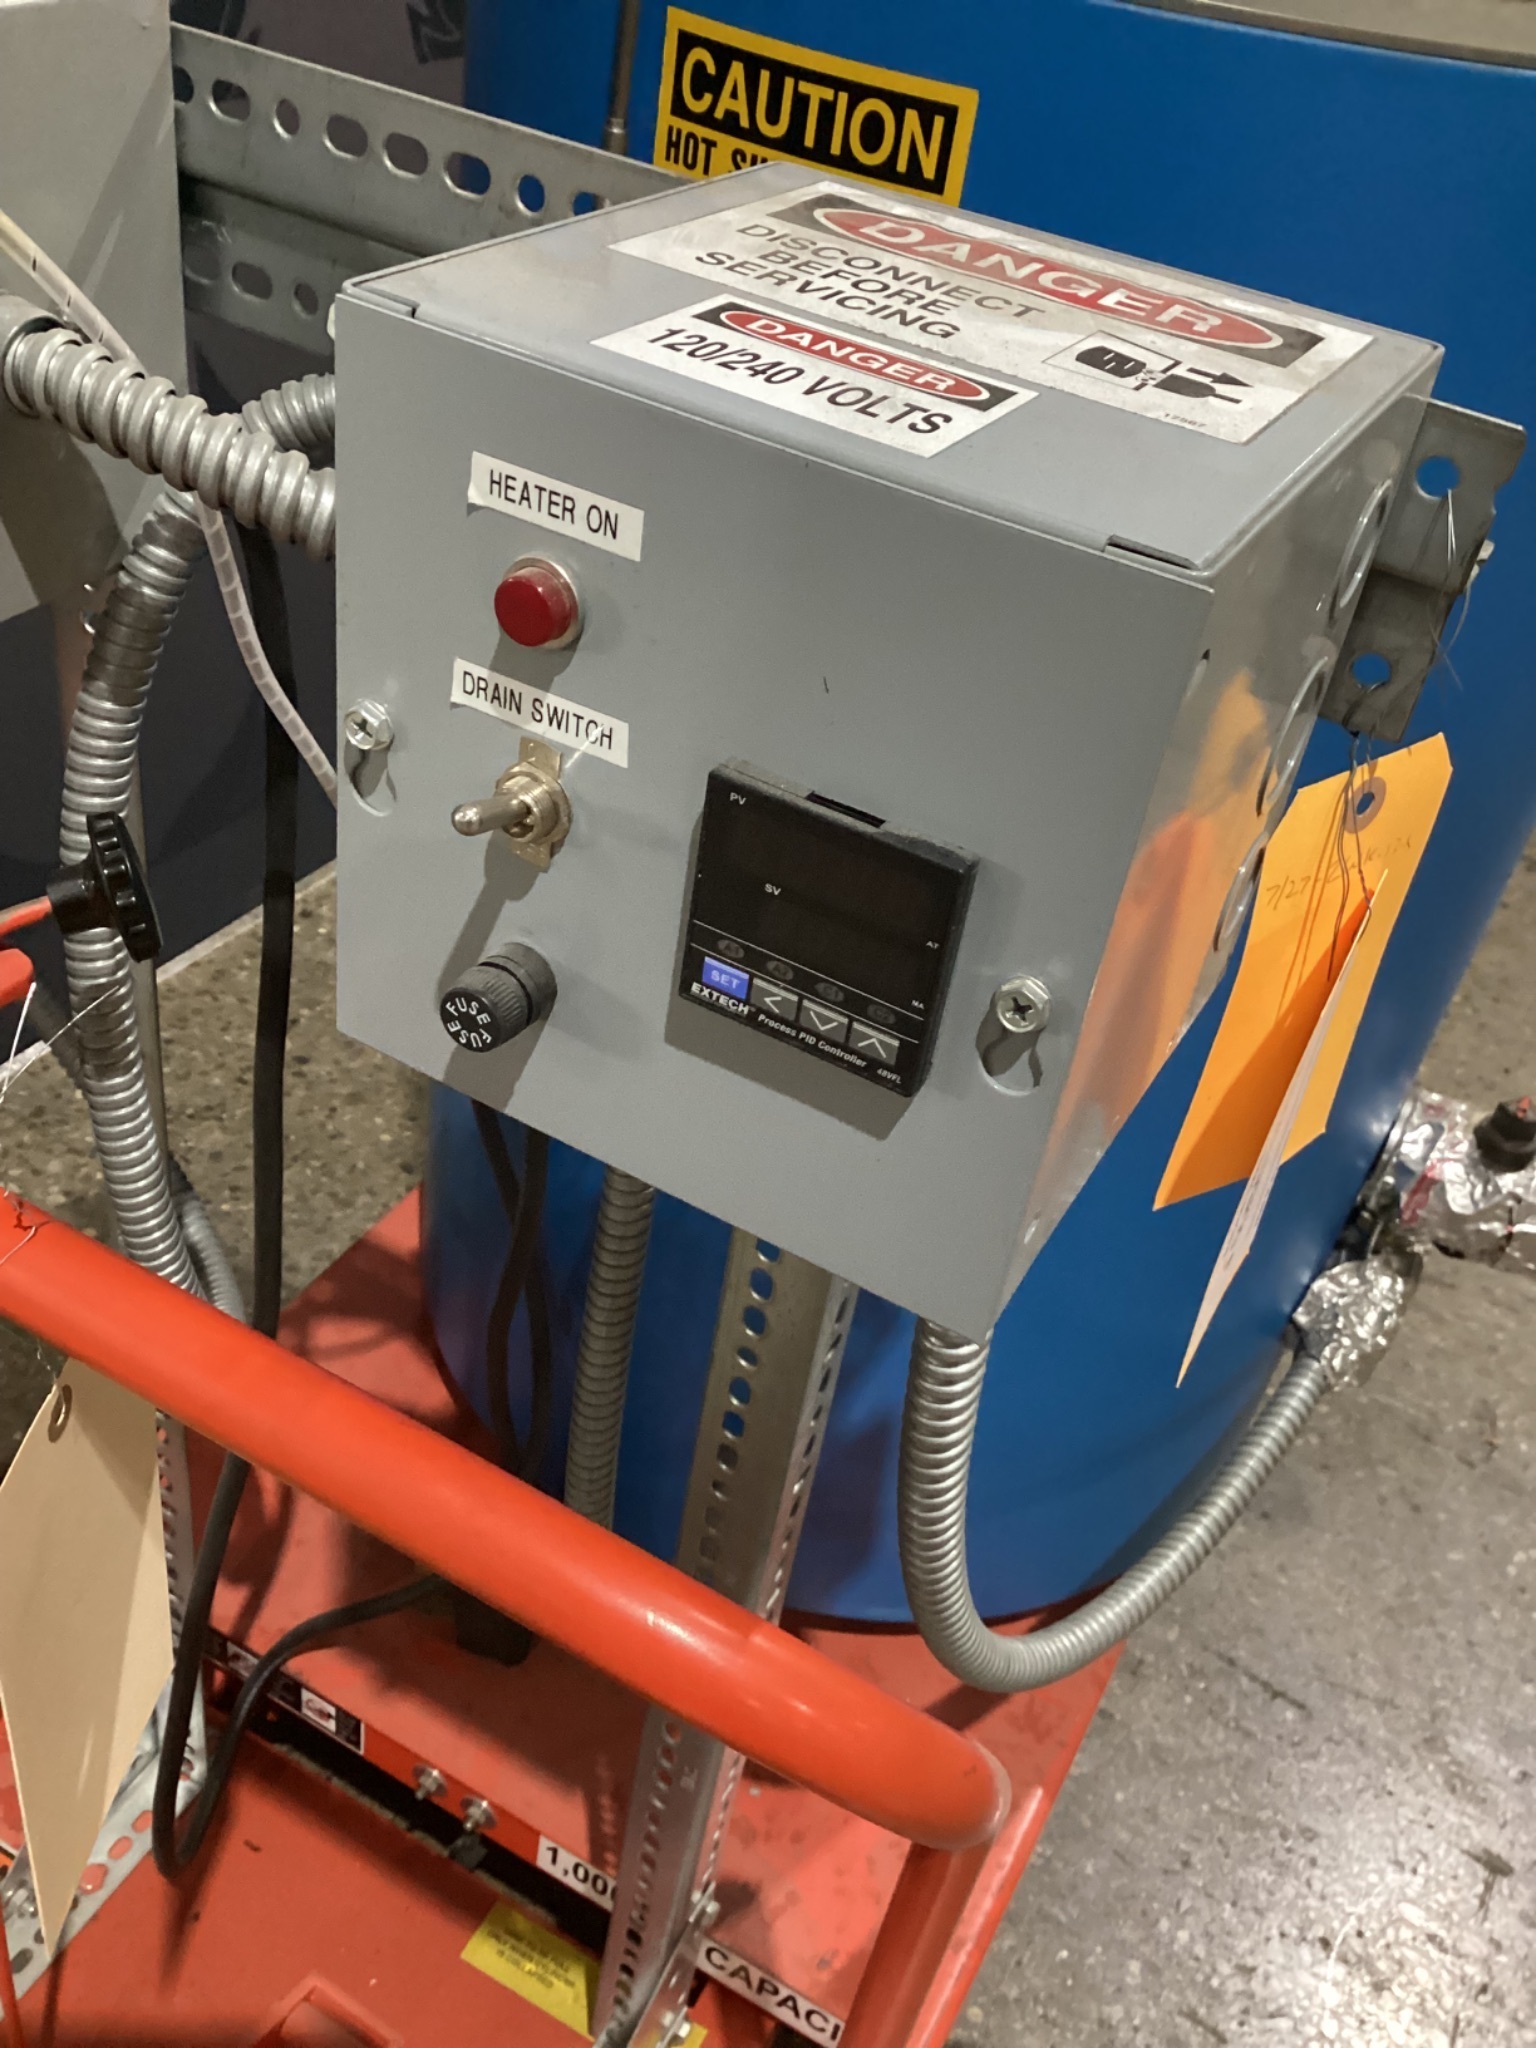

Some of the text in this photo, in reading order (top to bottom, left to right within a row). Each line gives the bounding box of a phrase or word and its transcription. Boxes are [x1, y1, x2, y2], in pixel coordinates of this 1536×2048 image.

[681, 47, 946, 180] CAUTION
[664, 123, 717, 176] HOT
[695, 251, 961, 339] SERVICING
[736, 224, 1046, 318] DISCONNECT
[758, 250, 961, 316] BEFORE
[858, 220, 1223, 333] DANGER
[647, 327, 953, 435] 120/240 VOLTS
[745, 318, 960, 392] DANGER
[489, 469, 619, 540] HEATER ON
[462, 670, 614, 750] DRAIN SWITCH
[729, 791, 747, 805] PV
[764, 883, 782, 895] SV
[925, 940, 940, 949] AT
[445, 997, 492, 1025] FUSE
[690, 981, 749, 1015] EXTECH
[711, 969, 740, 989] SET
[447, 1020, 492, 1048] FUSE
[757, 1013, 868, 1068] Process PID Controller
[706, 1946, 841, 2041] CAPACI
